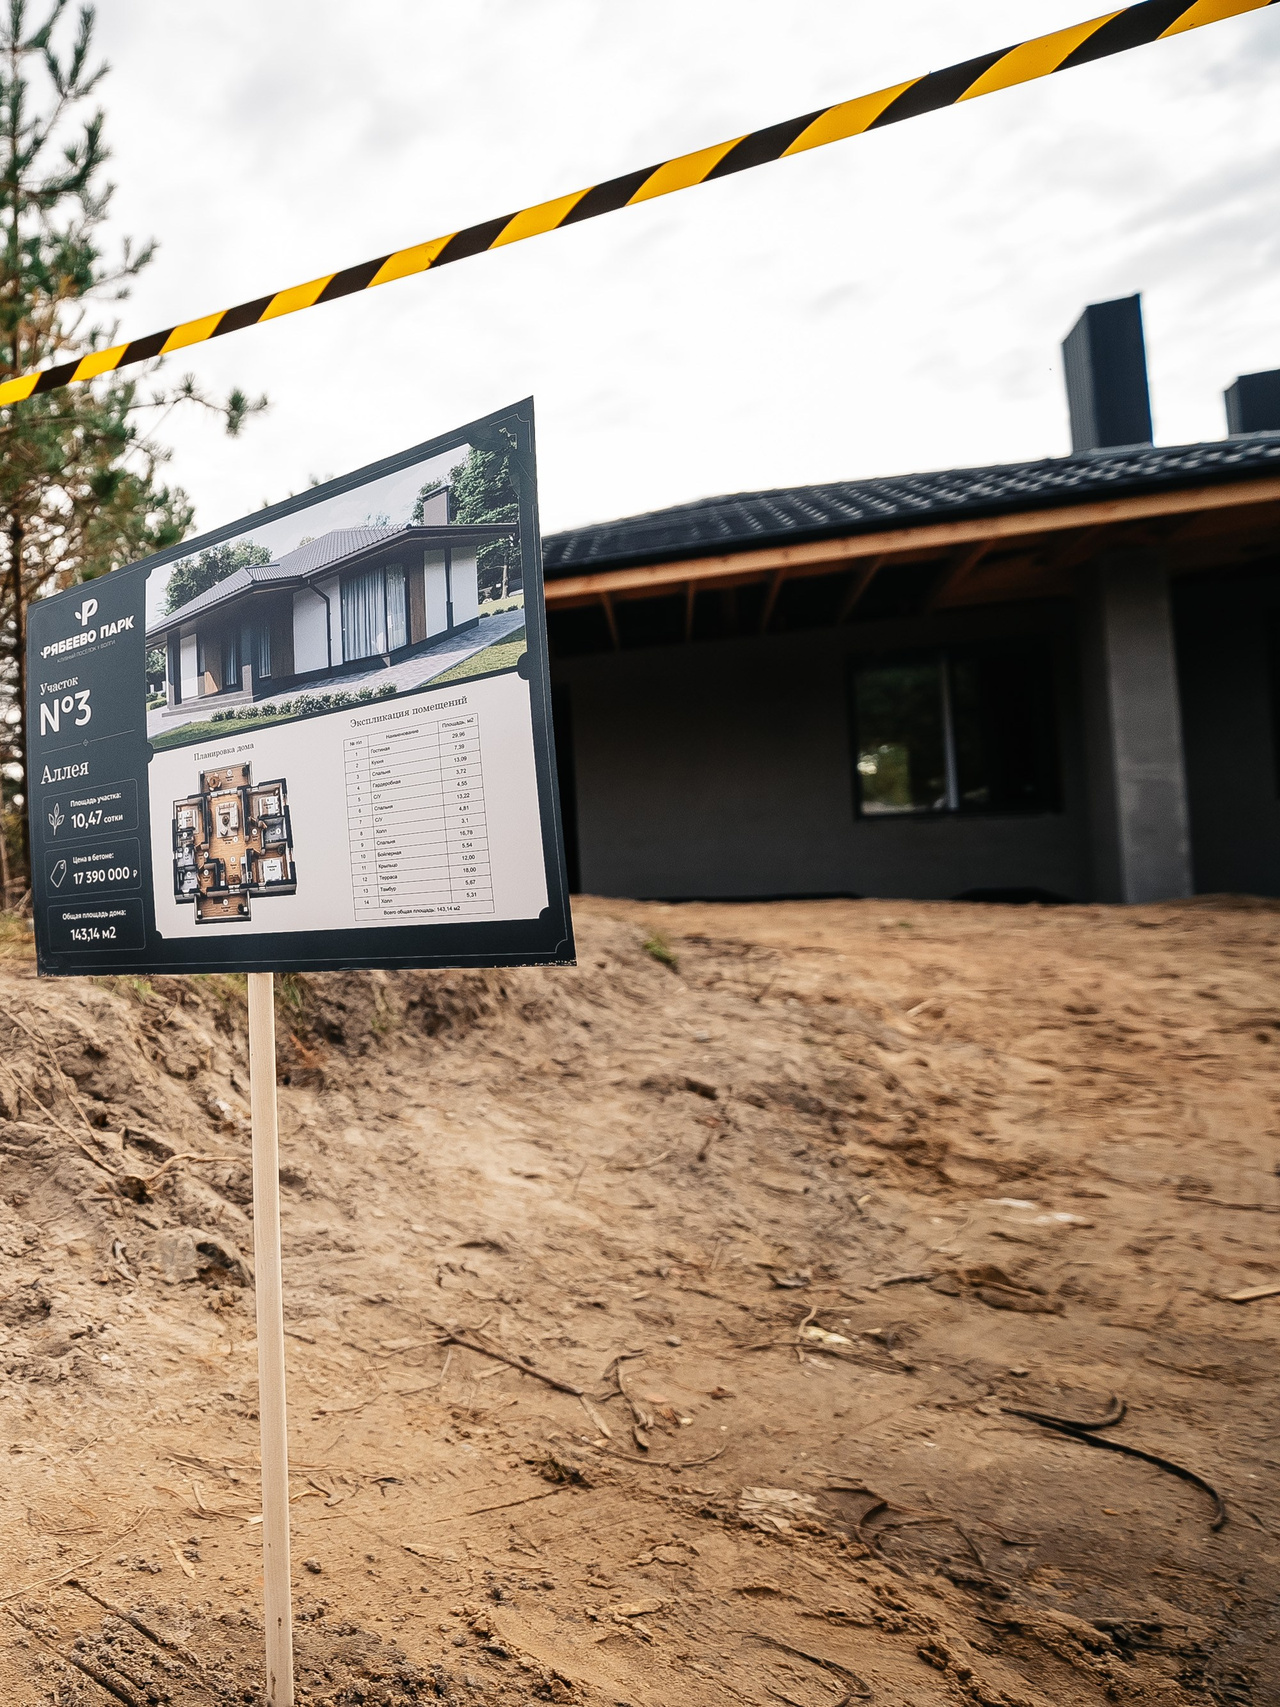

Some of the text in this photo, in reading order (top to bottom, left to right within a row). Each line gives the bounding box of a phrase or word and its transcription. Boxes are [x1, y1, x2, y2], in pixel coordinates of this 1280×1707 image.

[40, 615, 134, 658] РЯБЕЕВО ПАРК
[40, 677, 79, 695] Участок
[350, 696, 468, 728] Экспликация помещений
[385, 728, 419, 739] Наименование
[193, 743, 254, 761] Планировка дома
[371, 746, 390, 754] Гостиная
[40, 761, 89, 784] Аллея
[373, 780, 401, 788] Гардеробная
[70, 792, 122, 807] Площадь участка:
[71, 809, 123, 829] 10,47 сотки
[73, 856, 87, 864] Цена
[91, 852, 114, 861] бетоне:
[73, 872, 84, 884] 17
[86, 869, 106, 884] 390
[108, 866, 130, 881] 000
[62, 909, 127, 921] Общая площадь дома:
[70, 926, 116, 942] 143,14 м2
